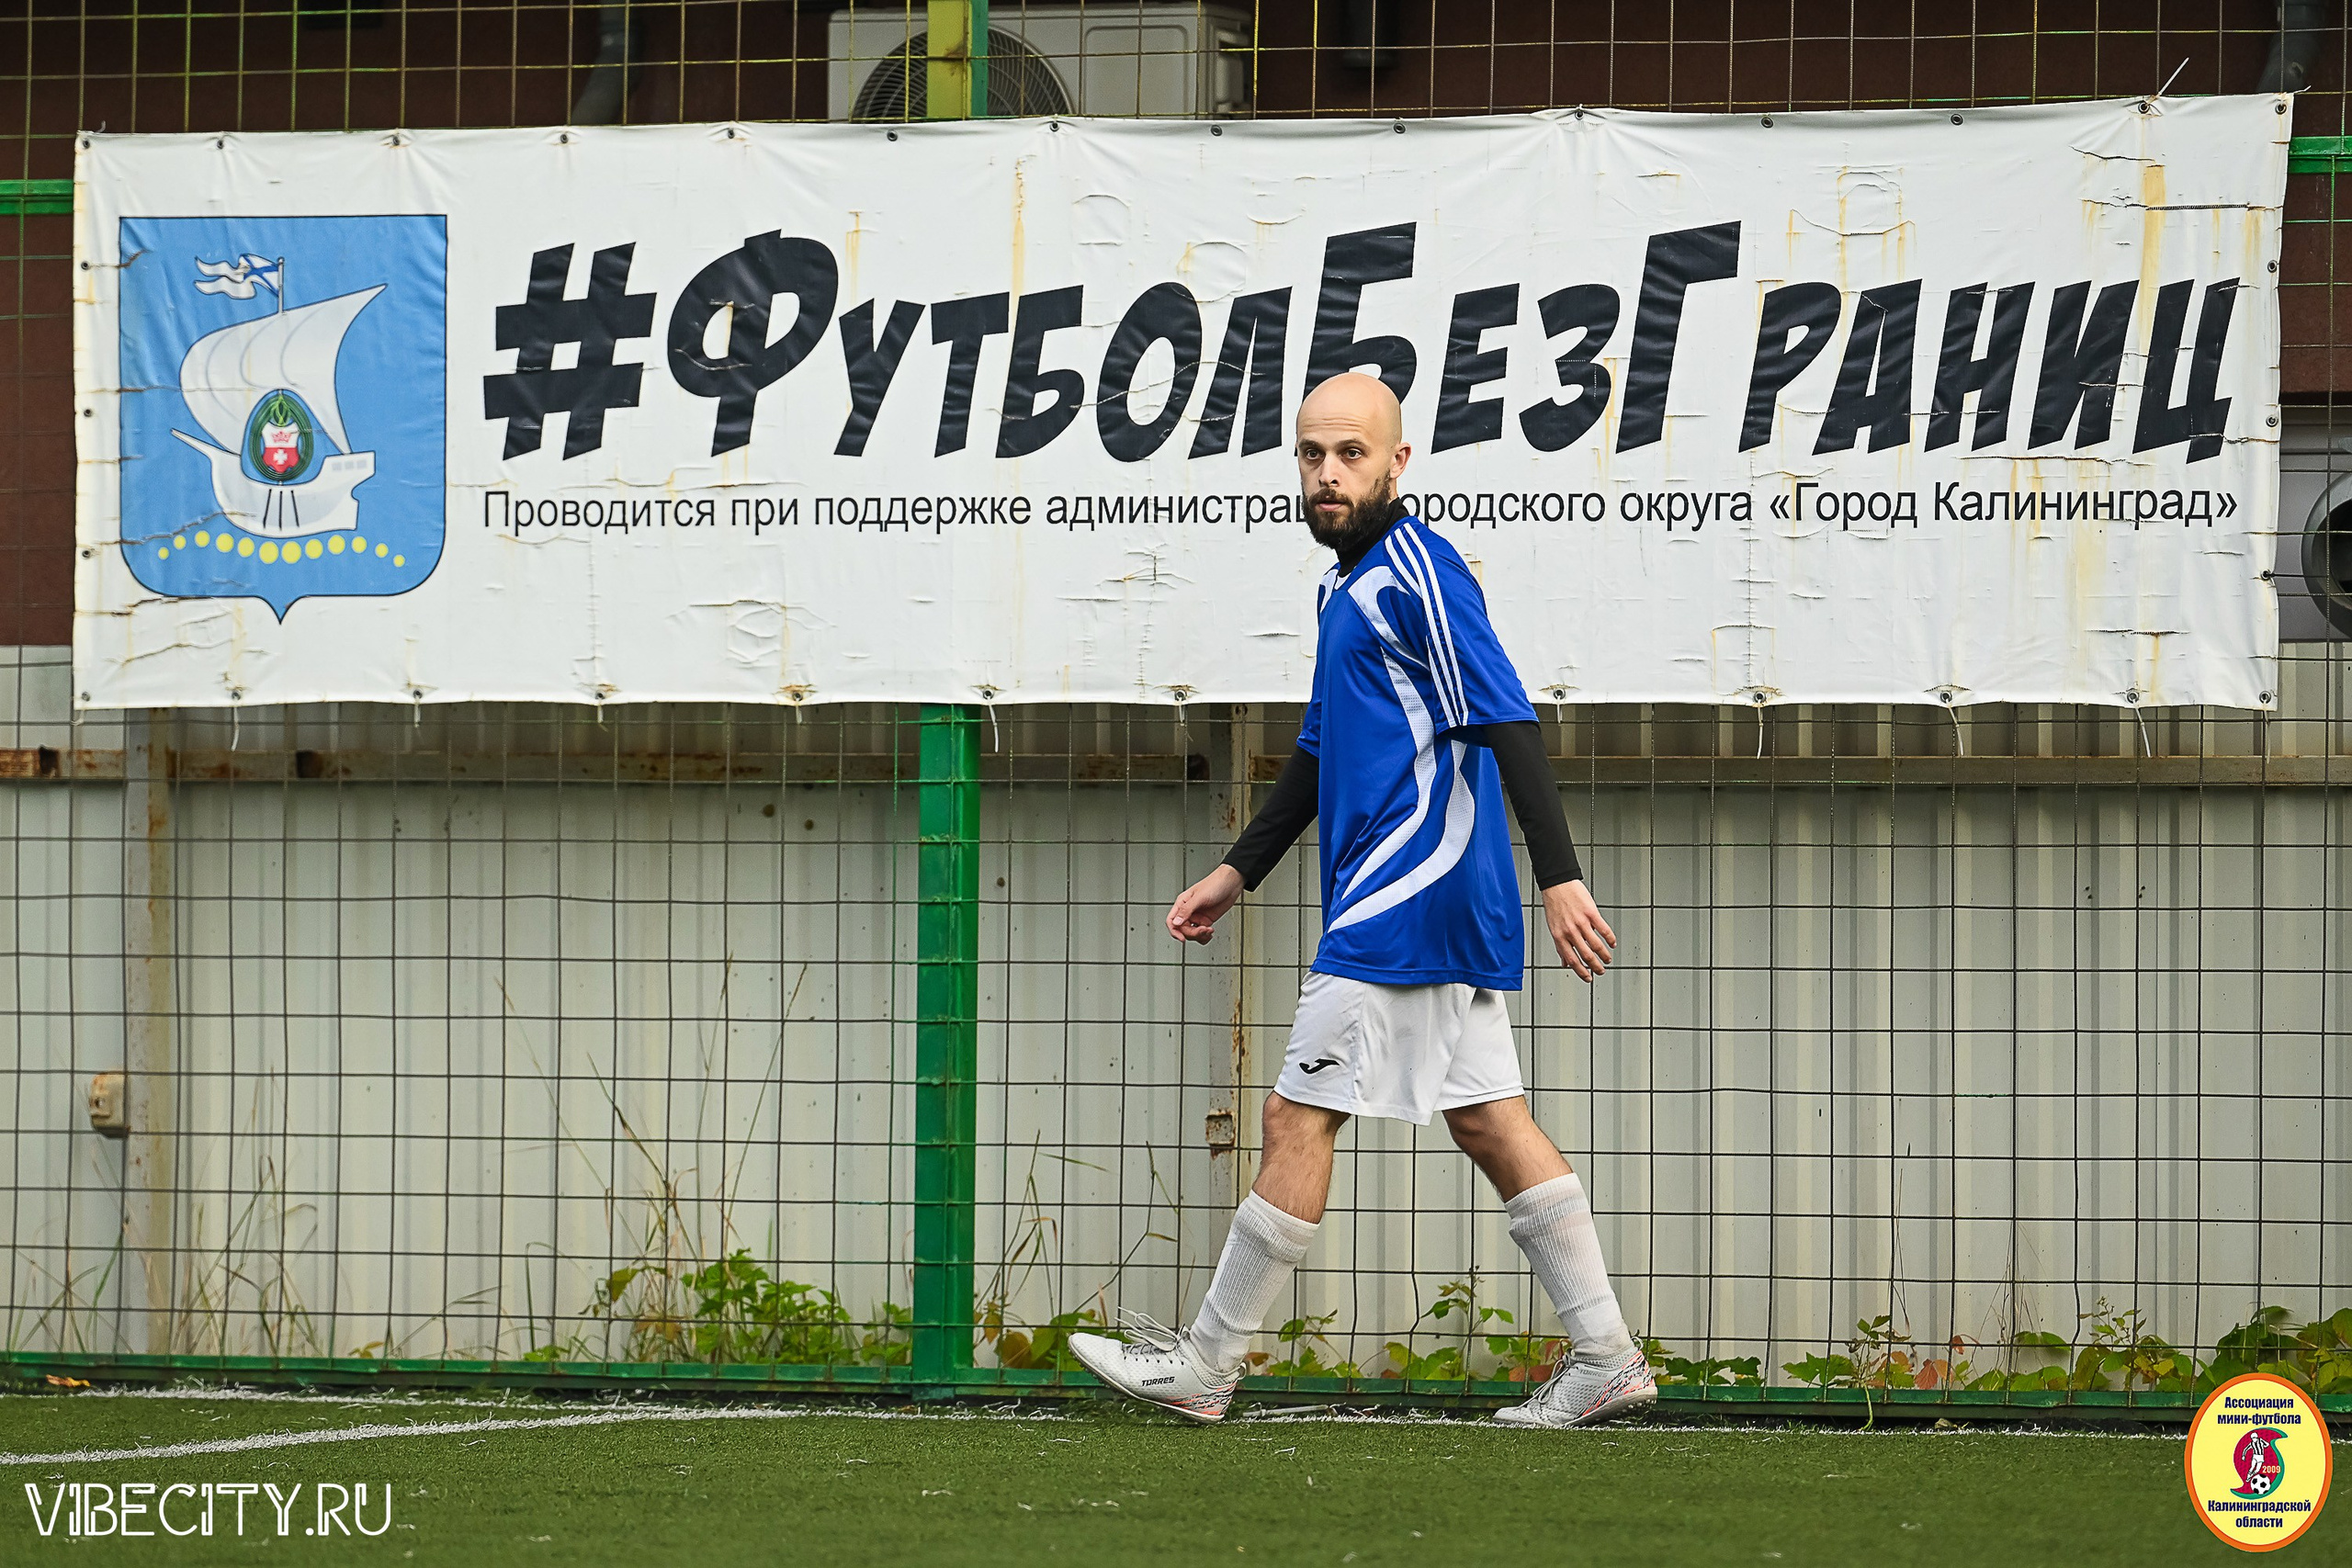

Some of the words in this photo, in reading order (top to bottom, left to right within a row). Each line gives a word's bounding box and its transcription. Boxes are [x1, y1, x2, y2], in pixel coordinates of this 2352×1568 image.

[484, 491, 715, 534] Проводится
[731, 499, 799, 536] при
[815, 496, 1032, 535] поддержке
[1046, 494, 1306, 533] администра
[1400, 491, 1606, 529] ородского
[1620, 492, 1753, 532] округа
[1770, 482, 1918, 532] «Город
[1934, 481, 2238, 533] Калининград»
[1141, 1376, 1175, 1387] TORRES
